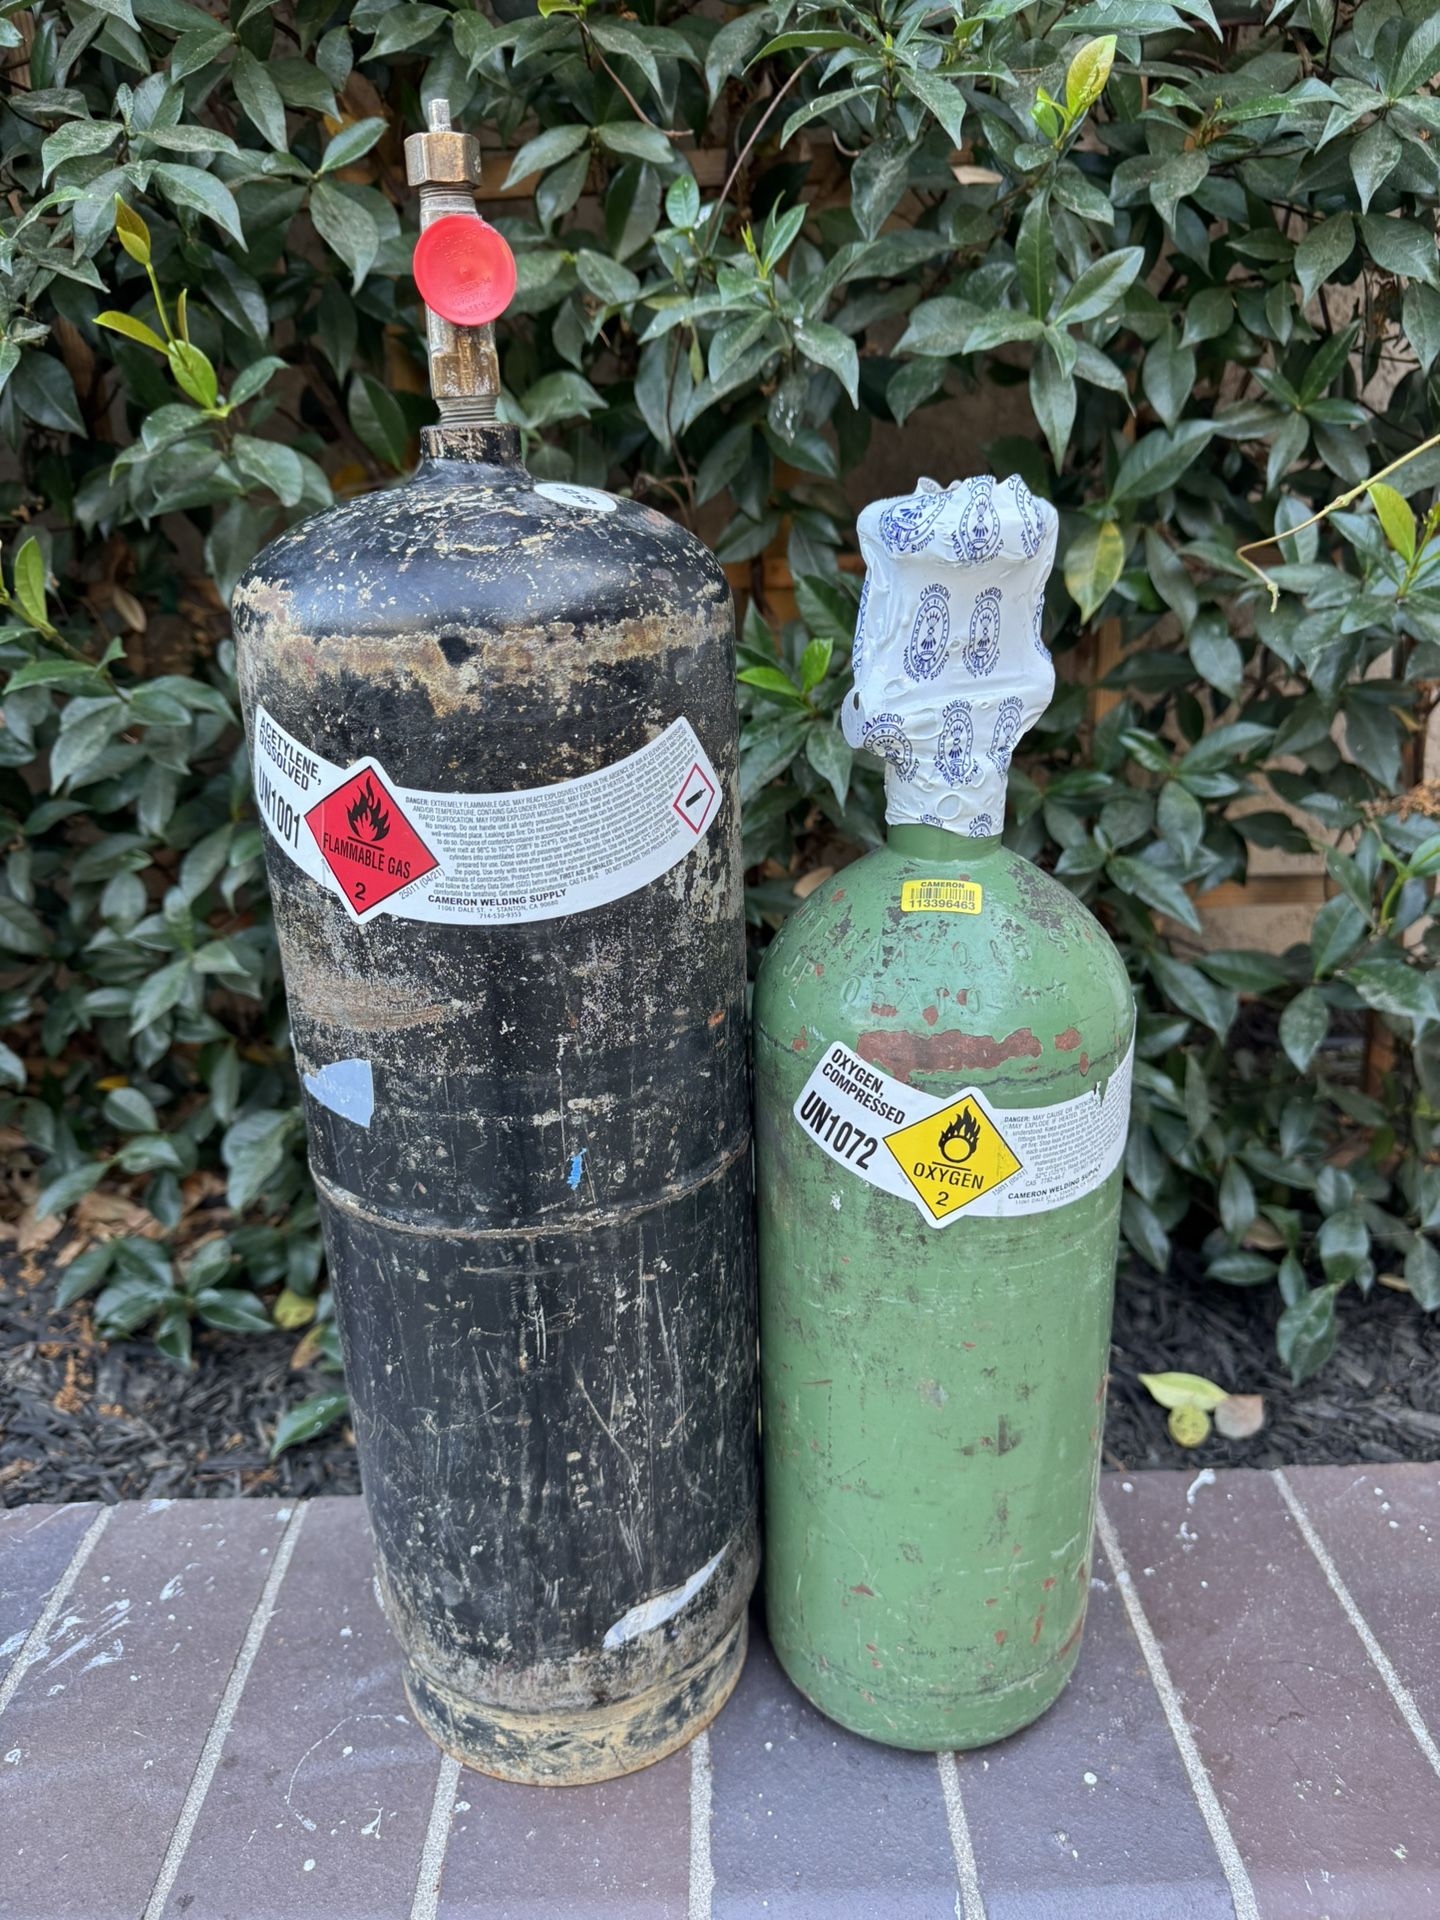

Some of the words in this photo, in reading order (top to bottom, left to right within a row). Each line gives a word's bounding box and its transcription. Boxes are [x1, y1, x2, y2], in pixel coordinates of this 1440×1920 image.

[920, 584, 951, 601] CAMERON
[975, 586, 1003, 604] CAMERON
[942, 700, 972, 718] CAMERON
[862, 713, 905, 736] CAMERON
[259, 732, 308, 791] DISSOLVED
[260, 717, 322, 786] ACETYLENE,
[259, 766, 300, 849] UN1001
[323, 833, 384, 872] FLAMMABLE
[388, 856, 410, 880] GAS
[355, 882, 366, 900] 2
[399, 884, 420, 900] 25011
[428, 894, 477, 905] CAMERON
[480, 896, 526, 905] WELDING
[529, 888, 566, 902] SUPPLY
[910, 899, 975, 910] 113396463
[831, 1048, 884, 1095] OXYGEN,
[822, 1063, 906, 1124] COMPRESSED
[800, 1091, 878, 1170] UN1072
[913, 1162, 984, 1189] OXYGEN
[936, 1192, 949, 1206] 2
[1008, 1189, 1046, 1200] CAMERON
[1049, 1177, 1078, 1193] WELDING
